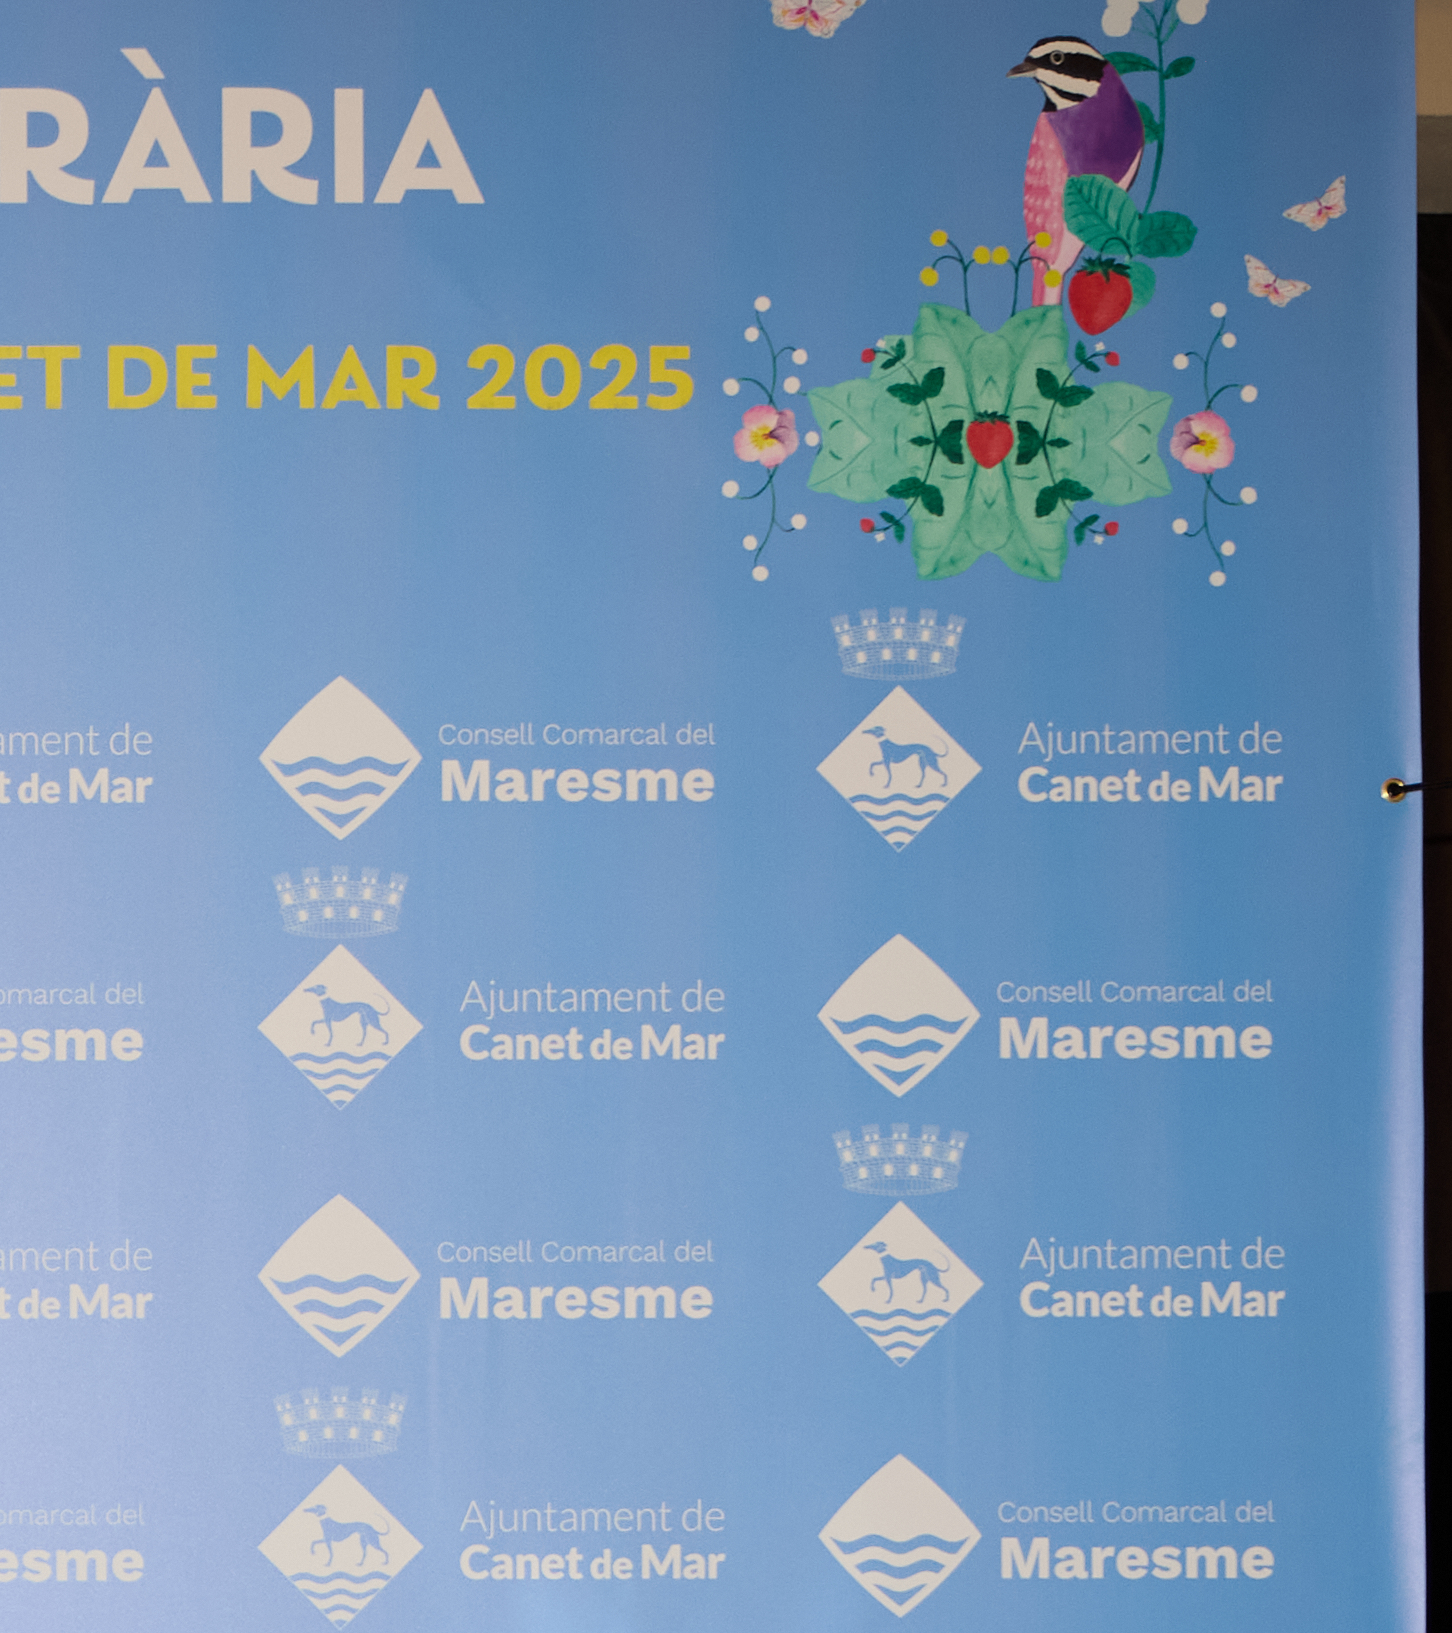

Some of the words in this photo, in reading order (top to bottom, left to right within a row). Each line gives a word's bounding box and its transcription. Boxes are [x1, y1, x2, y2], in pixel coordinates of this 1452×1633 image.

[108, 345, 217, 409] DE
[247, 345, 439, 409] MAR
[467, 344, 694, 410] 2025
[440, 724, 532, 744] Consell
[544, 724, 666, 744] Comarcal
[676, 723, 714, 744] del
[1019, 722, 1229, 761] Ajuntament
[1239, 722, 1282, 754] de
[442, 759, 715, 802] Maresme
[1018, 765, 1142, 802] Canet
[1147, 770, 1192, 802] de
[1199, 766, 1284, 802] Mar
[998, 982, 1090, 1002] Consell
[1101, 982, 1223, 1002] Comarcal
[1234, 981, 1272, 1001] del
[1000, 1016, 1273, 1059] Maresme
[110, 1240, 152, 1271] de
[18, 1288, 61, 1320] de
[69, 1283, 154, 1319] Mar
[999, 1502, 1092, 1522] Consell
[1103, 1502, 1225, 1522] Comarcal
[1236, 1501, 1273, 1522] del
[1001, 1537, 1275, 1579] Maresme
